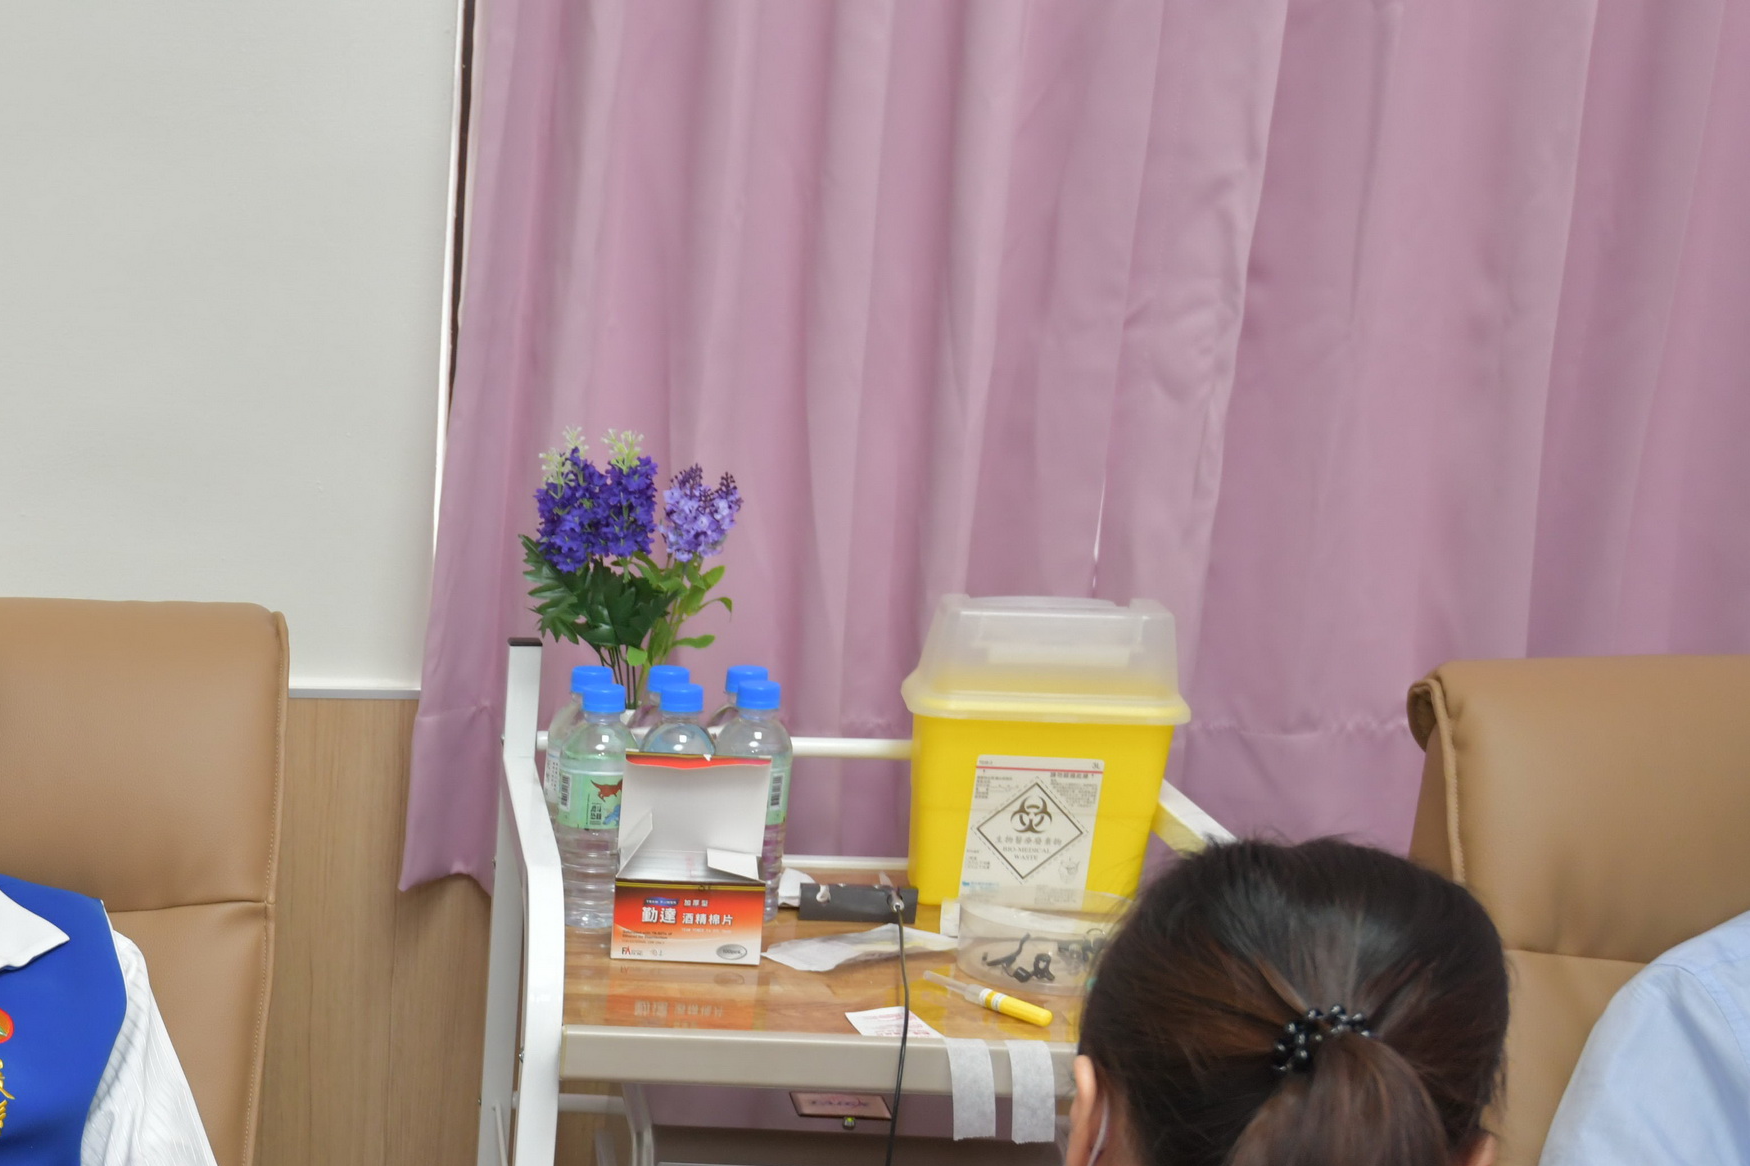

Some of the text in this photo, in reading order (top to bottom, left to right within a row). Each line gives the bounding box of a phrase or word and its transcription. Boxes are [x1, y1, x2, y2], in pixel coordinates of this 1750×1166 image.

[1003, 846, 1050, 854] BIO-MEDICAL
[642, 906, 677, 924] 勤達
[682, 913, 733, 926] 酒精棉片
